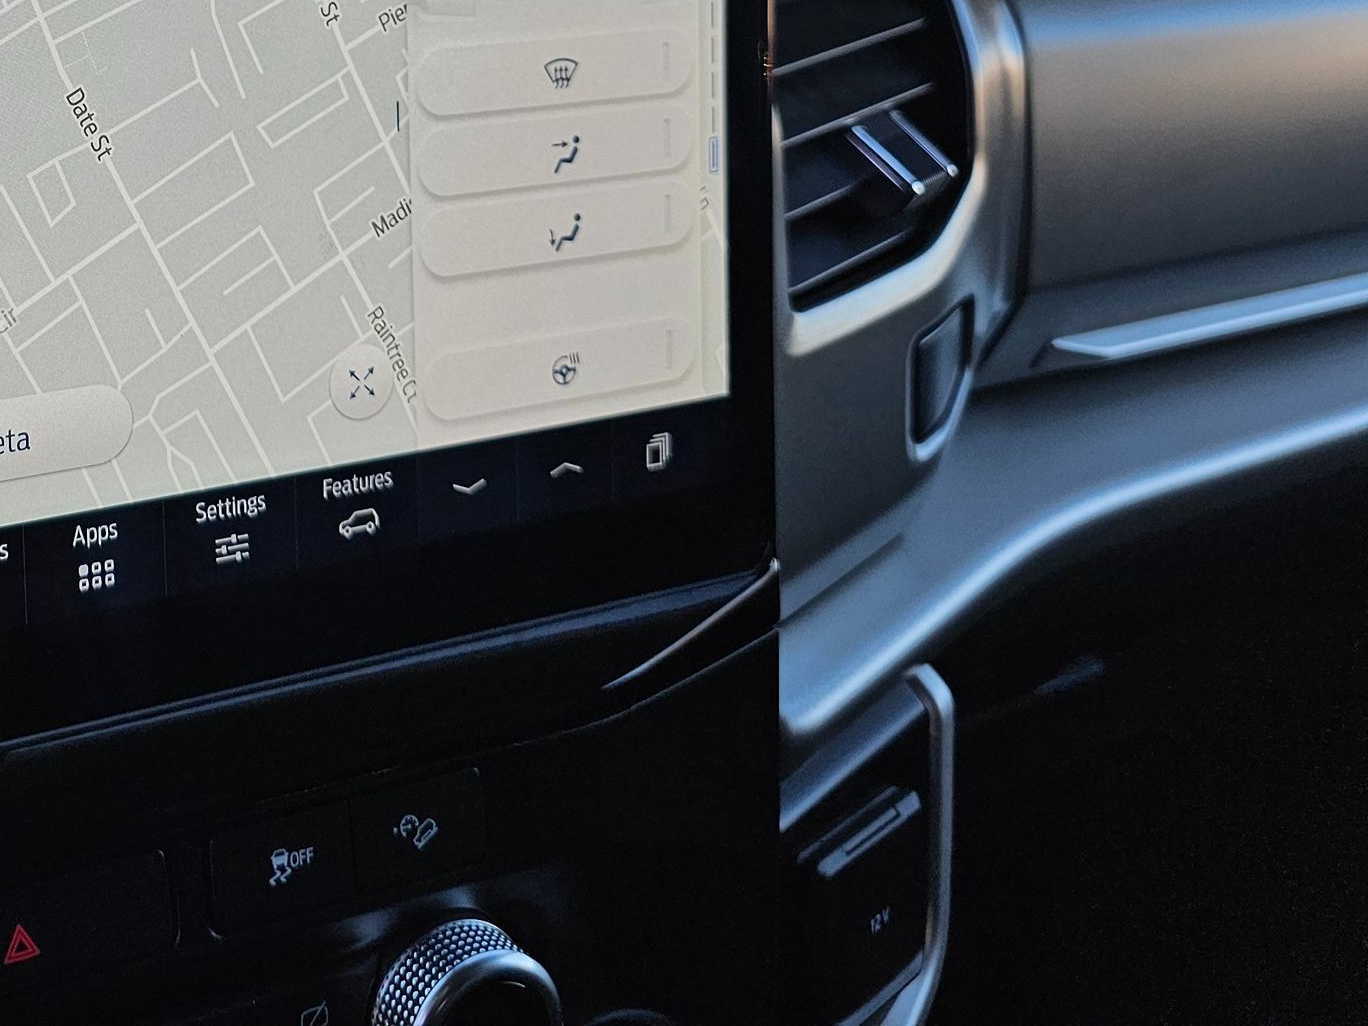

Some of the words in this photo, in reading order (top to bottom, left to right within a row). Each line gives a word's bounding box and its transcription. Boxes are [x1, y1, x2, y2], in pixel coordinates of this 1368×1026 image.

[320, 1, 340, 27] St
[65, 86, 98, 137] Date
[90, 134, 112, 162] St
[371, 198, 412, 238] Madi
[367, 305, 409, 382] Raintree
[322, 470, 394, 500] Features
[195, 493, 267, 525] Settings
[72, 521, 119, 549] Apps
[290, 846, 315, 868] OFF
